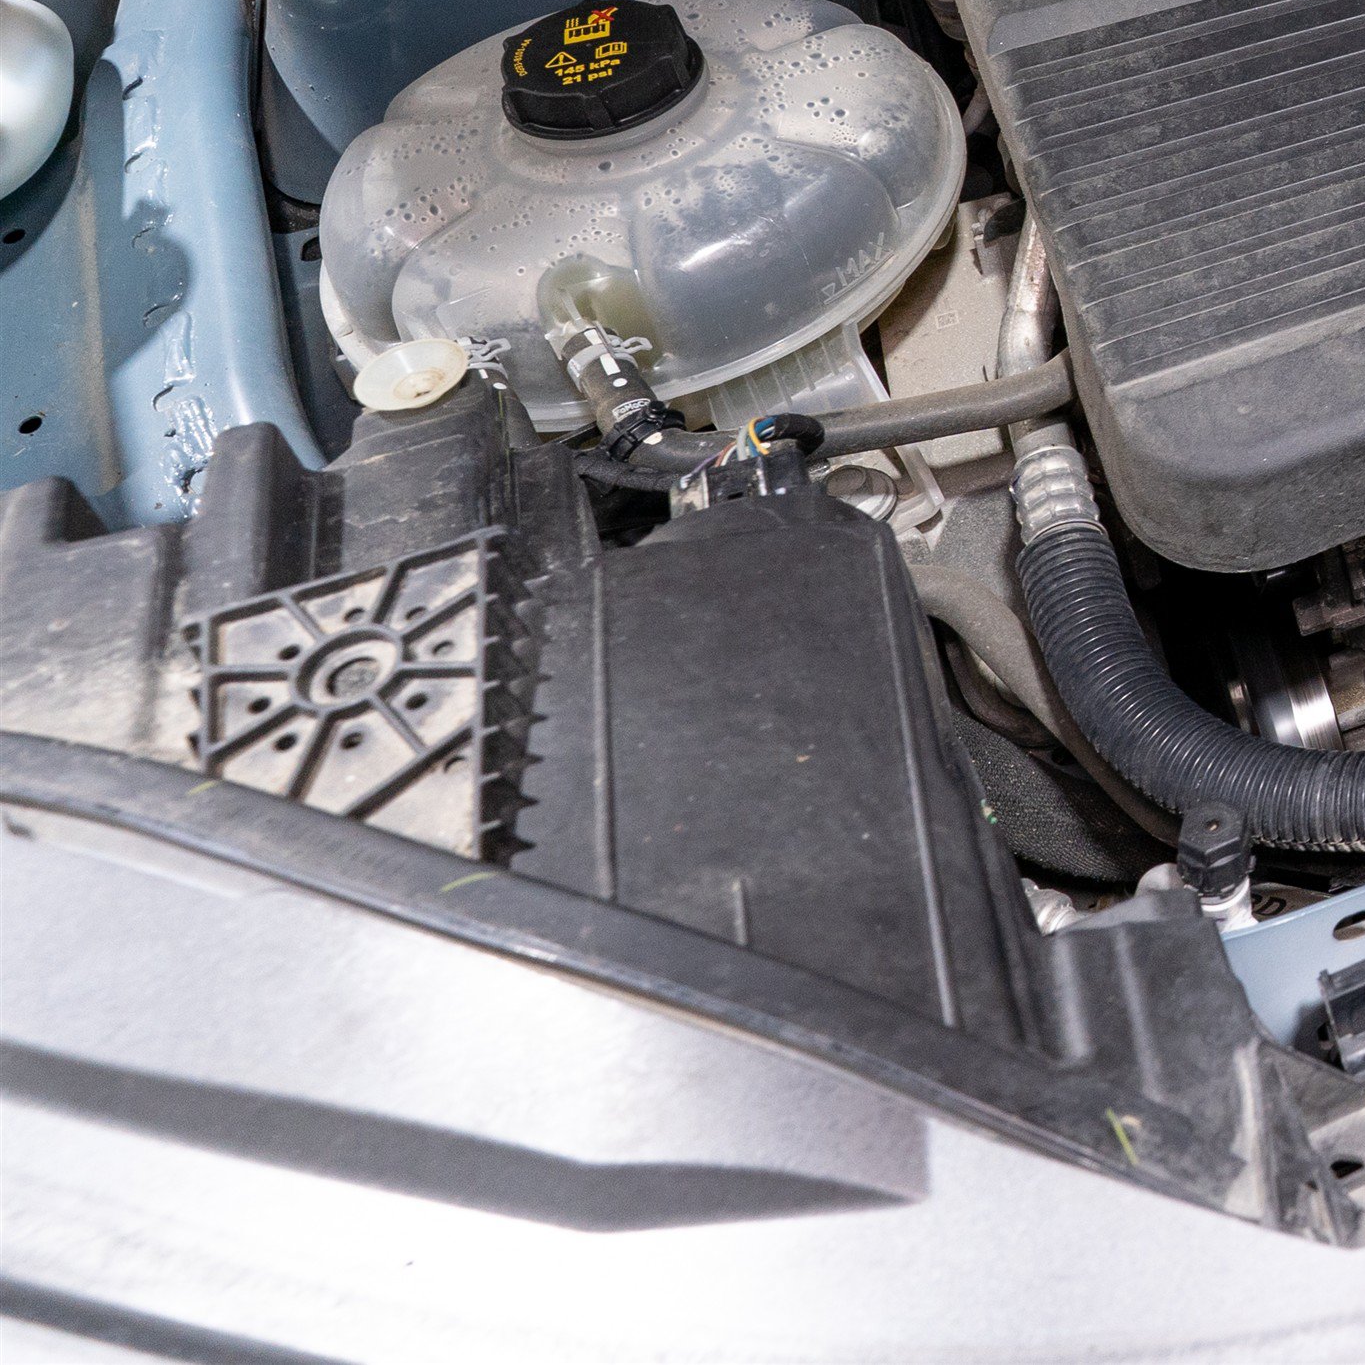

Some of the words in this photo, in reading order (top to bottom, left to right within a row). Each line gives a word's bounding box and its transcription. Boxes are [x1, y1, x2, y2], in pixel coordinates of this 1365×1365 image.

[554, 63, 586, 78] 145
[589, 57, 622, 72] kPa
[562, 74, 583, 86] 21
[587, 69, 614, 83] psi
[835, 231, 894, 287] MAX
